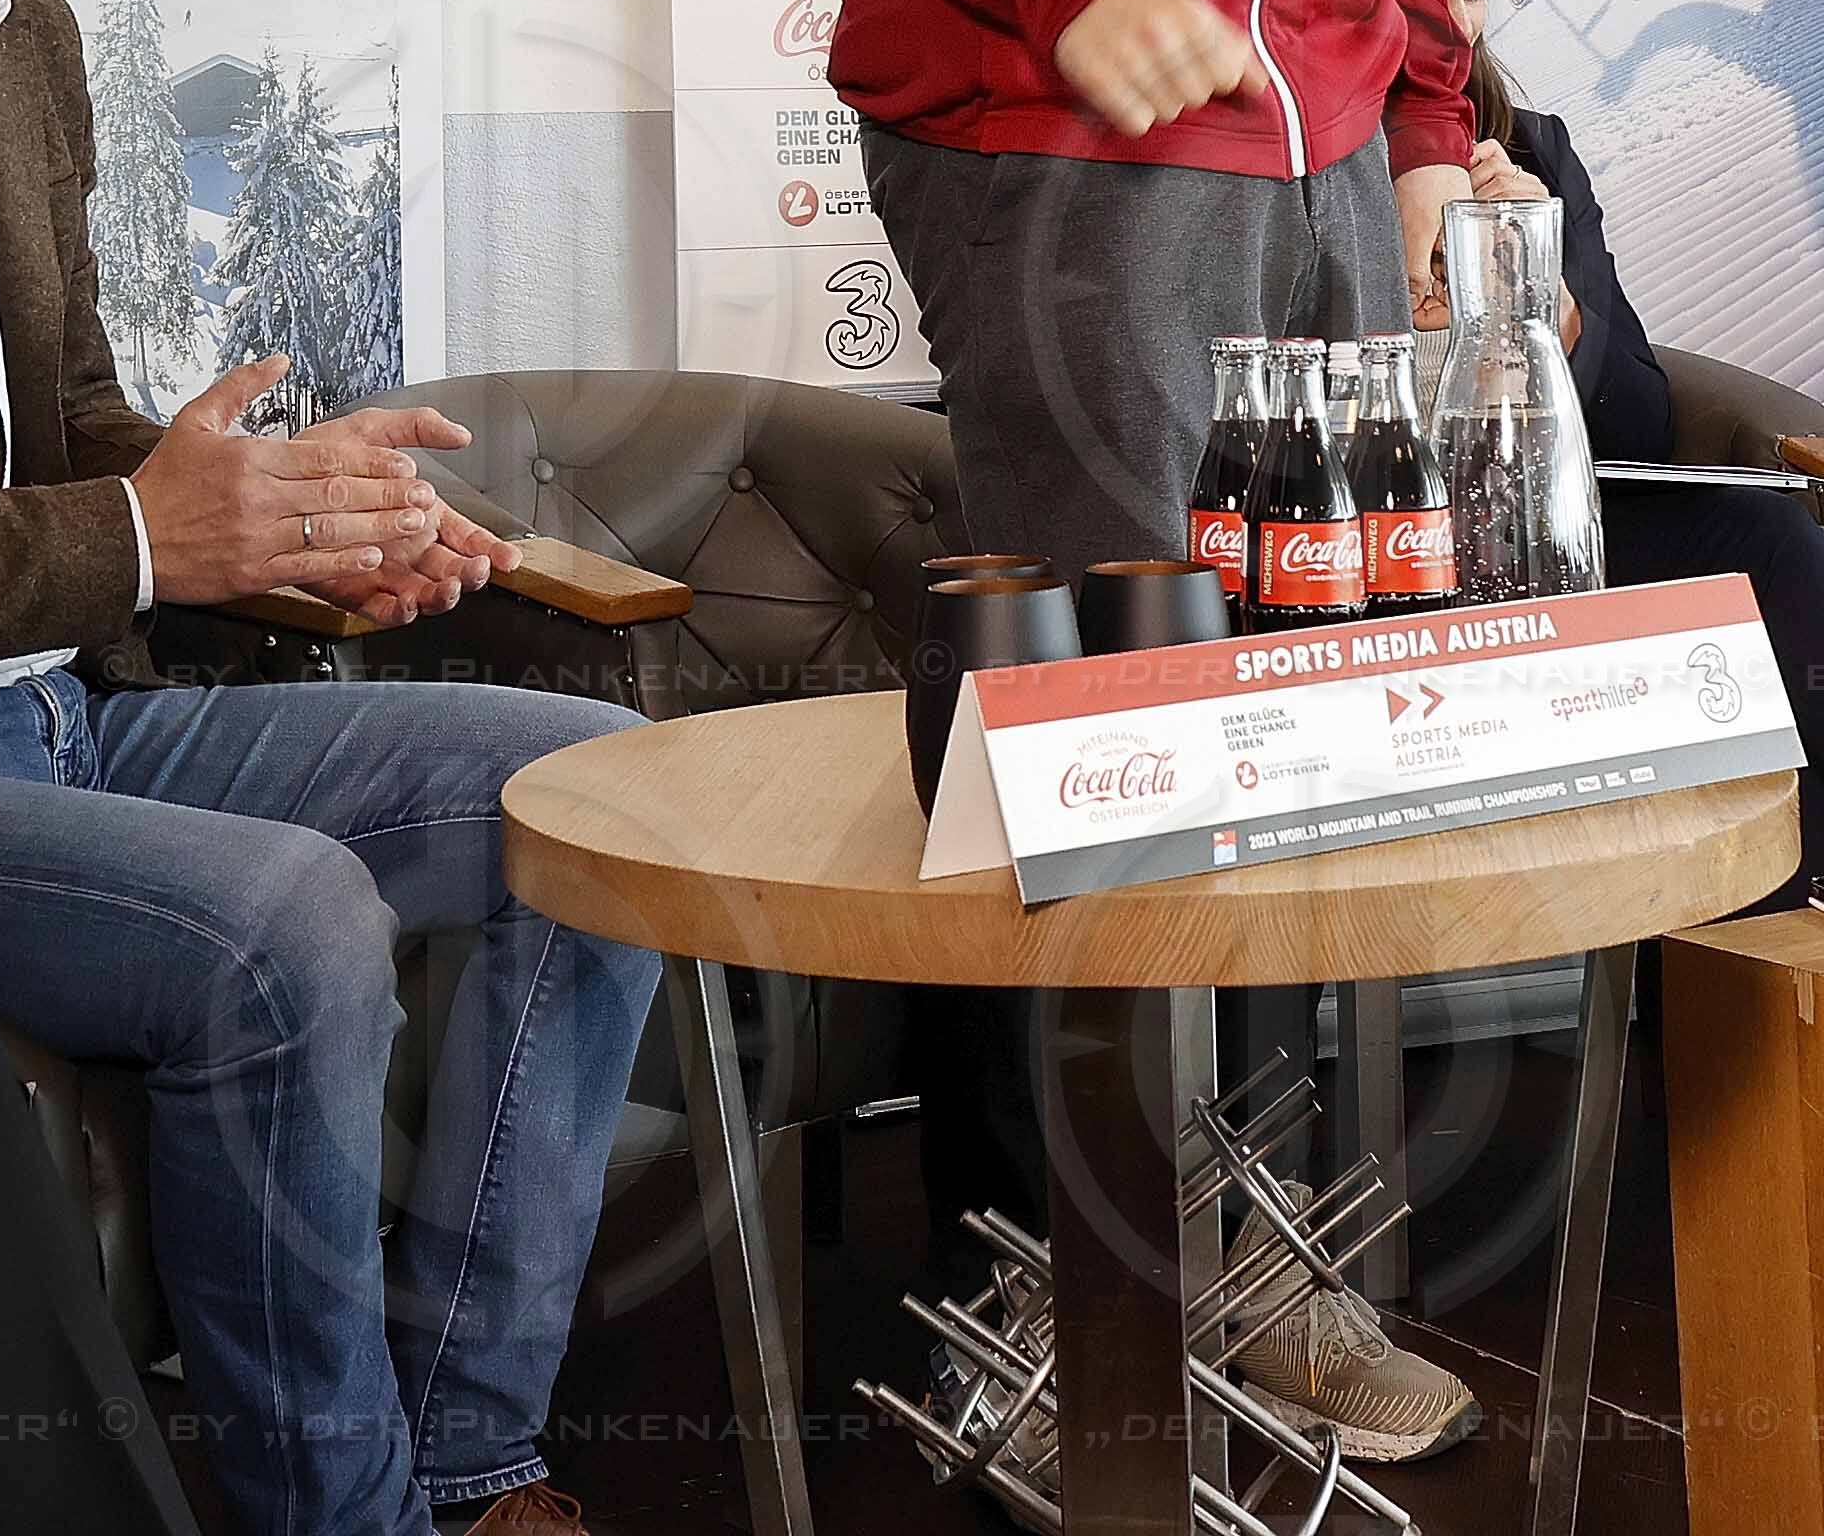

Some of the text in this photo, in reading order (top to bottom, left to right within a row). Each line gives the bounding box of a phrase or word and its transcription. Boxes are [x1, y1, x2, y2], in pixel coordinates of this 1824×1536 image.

[776, 110, 818, 126] DEM
[776, 130, 819, 146] EINE
[776, 149, 840, 165] GEBEN
[825, 190, 868, 200] öster
[1263, 529, 1274, 596] MEHRWEG
[1368, 519, 1378, 584] MEHRWEG
[1234, 612, 1558, 682] SPORTS MEDIA AUSTRIA
[1551, 683, 1638, 721] sporthilfe
[1221, 707, 1286, 727] DEM GLÜCK
[1224, 719, 1298, 739] EINE CHANCE
[1391, 719, 1509, 749] SPORTS MEDIA
[1227, 737, 1264, 752] GEBEN
[1396, 746, 1461, 768] AUSTRIA
[1059, 749, 1177, 808] Coca-Cola
[1262, 763, 1330, 781] LOTTERIEN
[1089, 800, 1169, 824] ÖSTERREICH
[1248, 832, 1276, 850] 2023
[1277, 825, 1318, 845] WORLD
[1319, 814, 1377, 839] MOUNTAIN
[1378, 810, 1403, 828] AND
[1403, 804, 1434, 823] TRAIL
[1435, 796, 1483, 817] RUNNING
[1483, 782, 1567, 809] CHAMPIONSHIPS
